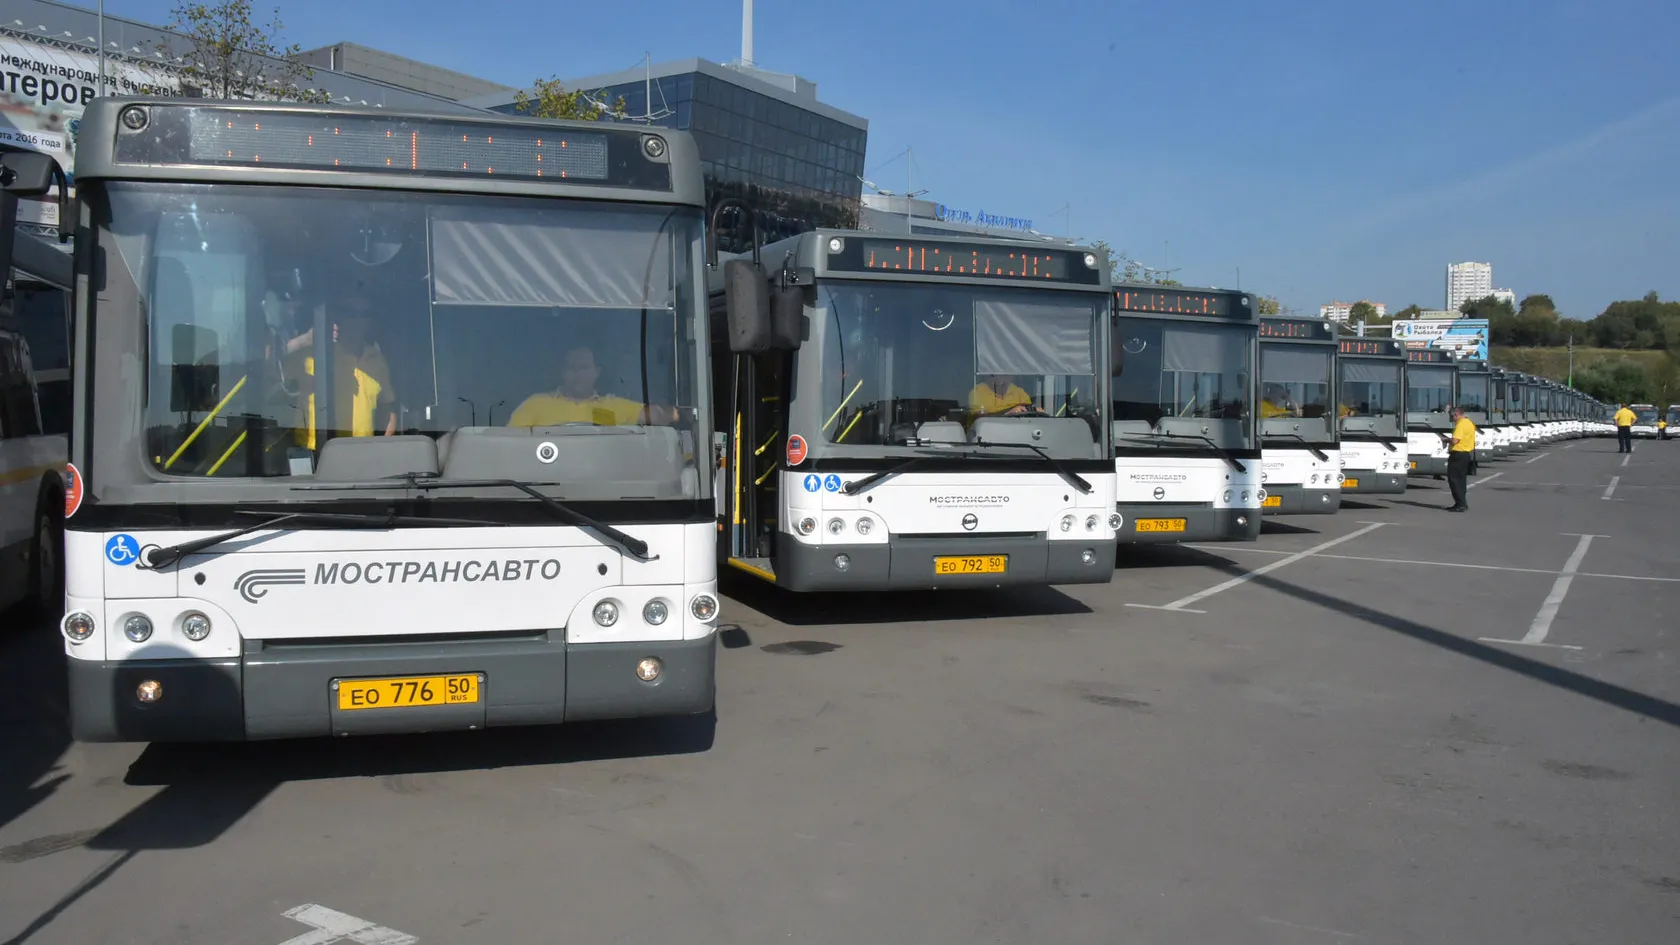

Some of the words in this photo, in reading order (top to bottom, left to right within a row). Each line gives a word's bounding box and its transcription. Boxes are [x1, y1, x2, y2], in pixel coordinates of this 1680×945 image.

[15, 133, 38, 144] 2016
[41, 138, 61, 148] года
[1153, 520, 1169, 530] 793
[314, 558, 561, 585] МОСТРАНСАВТО
[961, 559, 983, 571] 792
[989, 558, 1001, 567] 50
[390, 680, 434, 704] 776
[448, 678, 470, 694] 50
